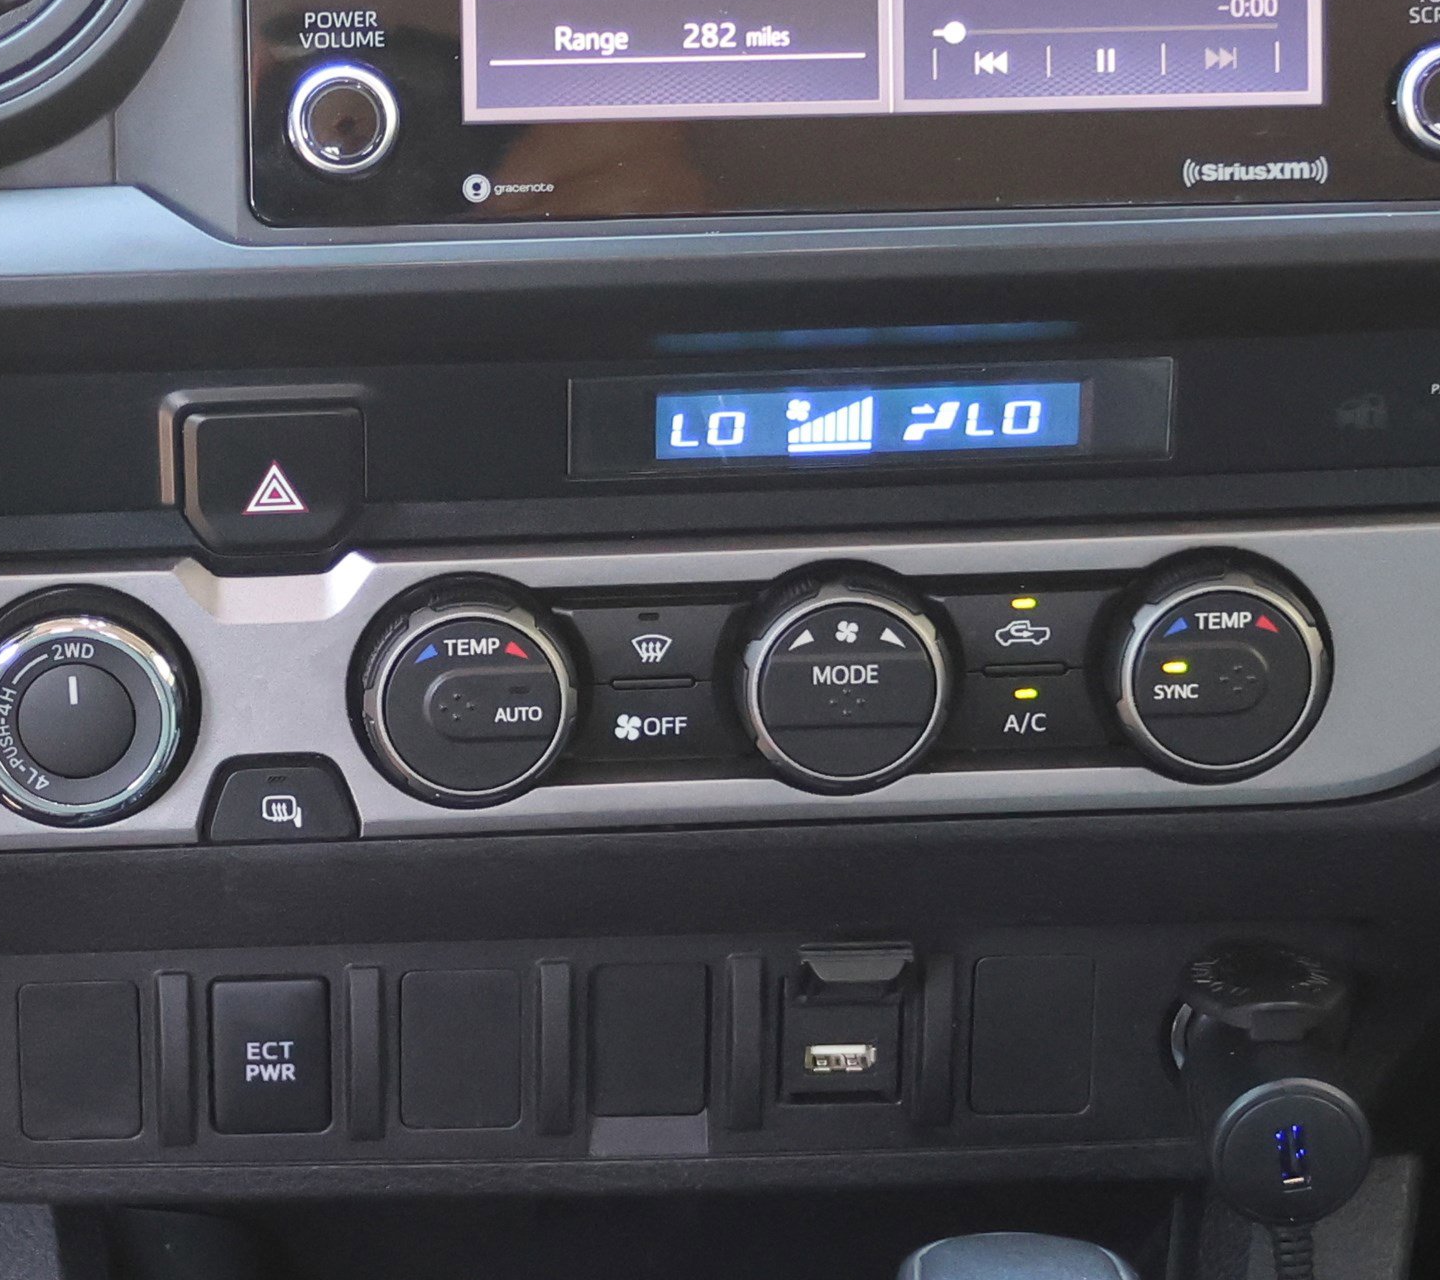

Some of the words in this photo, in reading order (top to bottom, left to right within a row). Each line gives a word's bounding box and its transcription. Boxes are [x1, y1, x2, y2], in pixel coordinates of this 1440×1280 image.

[304, 11, 378, 28] POWER
[299, 29, 385, 49] VOLUME
[554, 27, 628, 55] Range
[683, 24, 737, 49] 282
[746, 26, 790, 47] miles
[494, 182, 554, 196] gracenote
[965, 400, 1043, 436] LO
[669, 409, 747, 447] LO
[1195, 611, 1252, 630] TEMP
[51, 642, 94, 661] 2WD
[443, 639, 500, 658] TEMP
[811, 663, 880, 686] MODE
[1153, 683, 1199, 700] SYNC
[494, 706, 543, 723] AUTO
[1003, 712, 1047, 733] A/C
[643, 716, 688, 736] OFF
[246, 1042, 294, 1060] ECT
[246, 1063, 296, 1082] PWR
